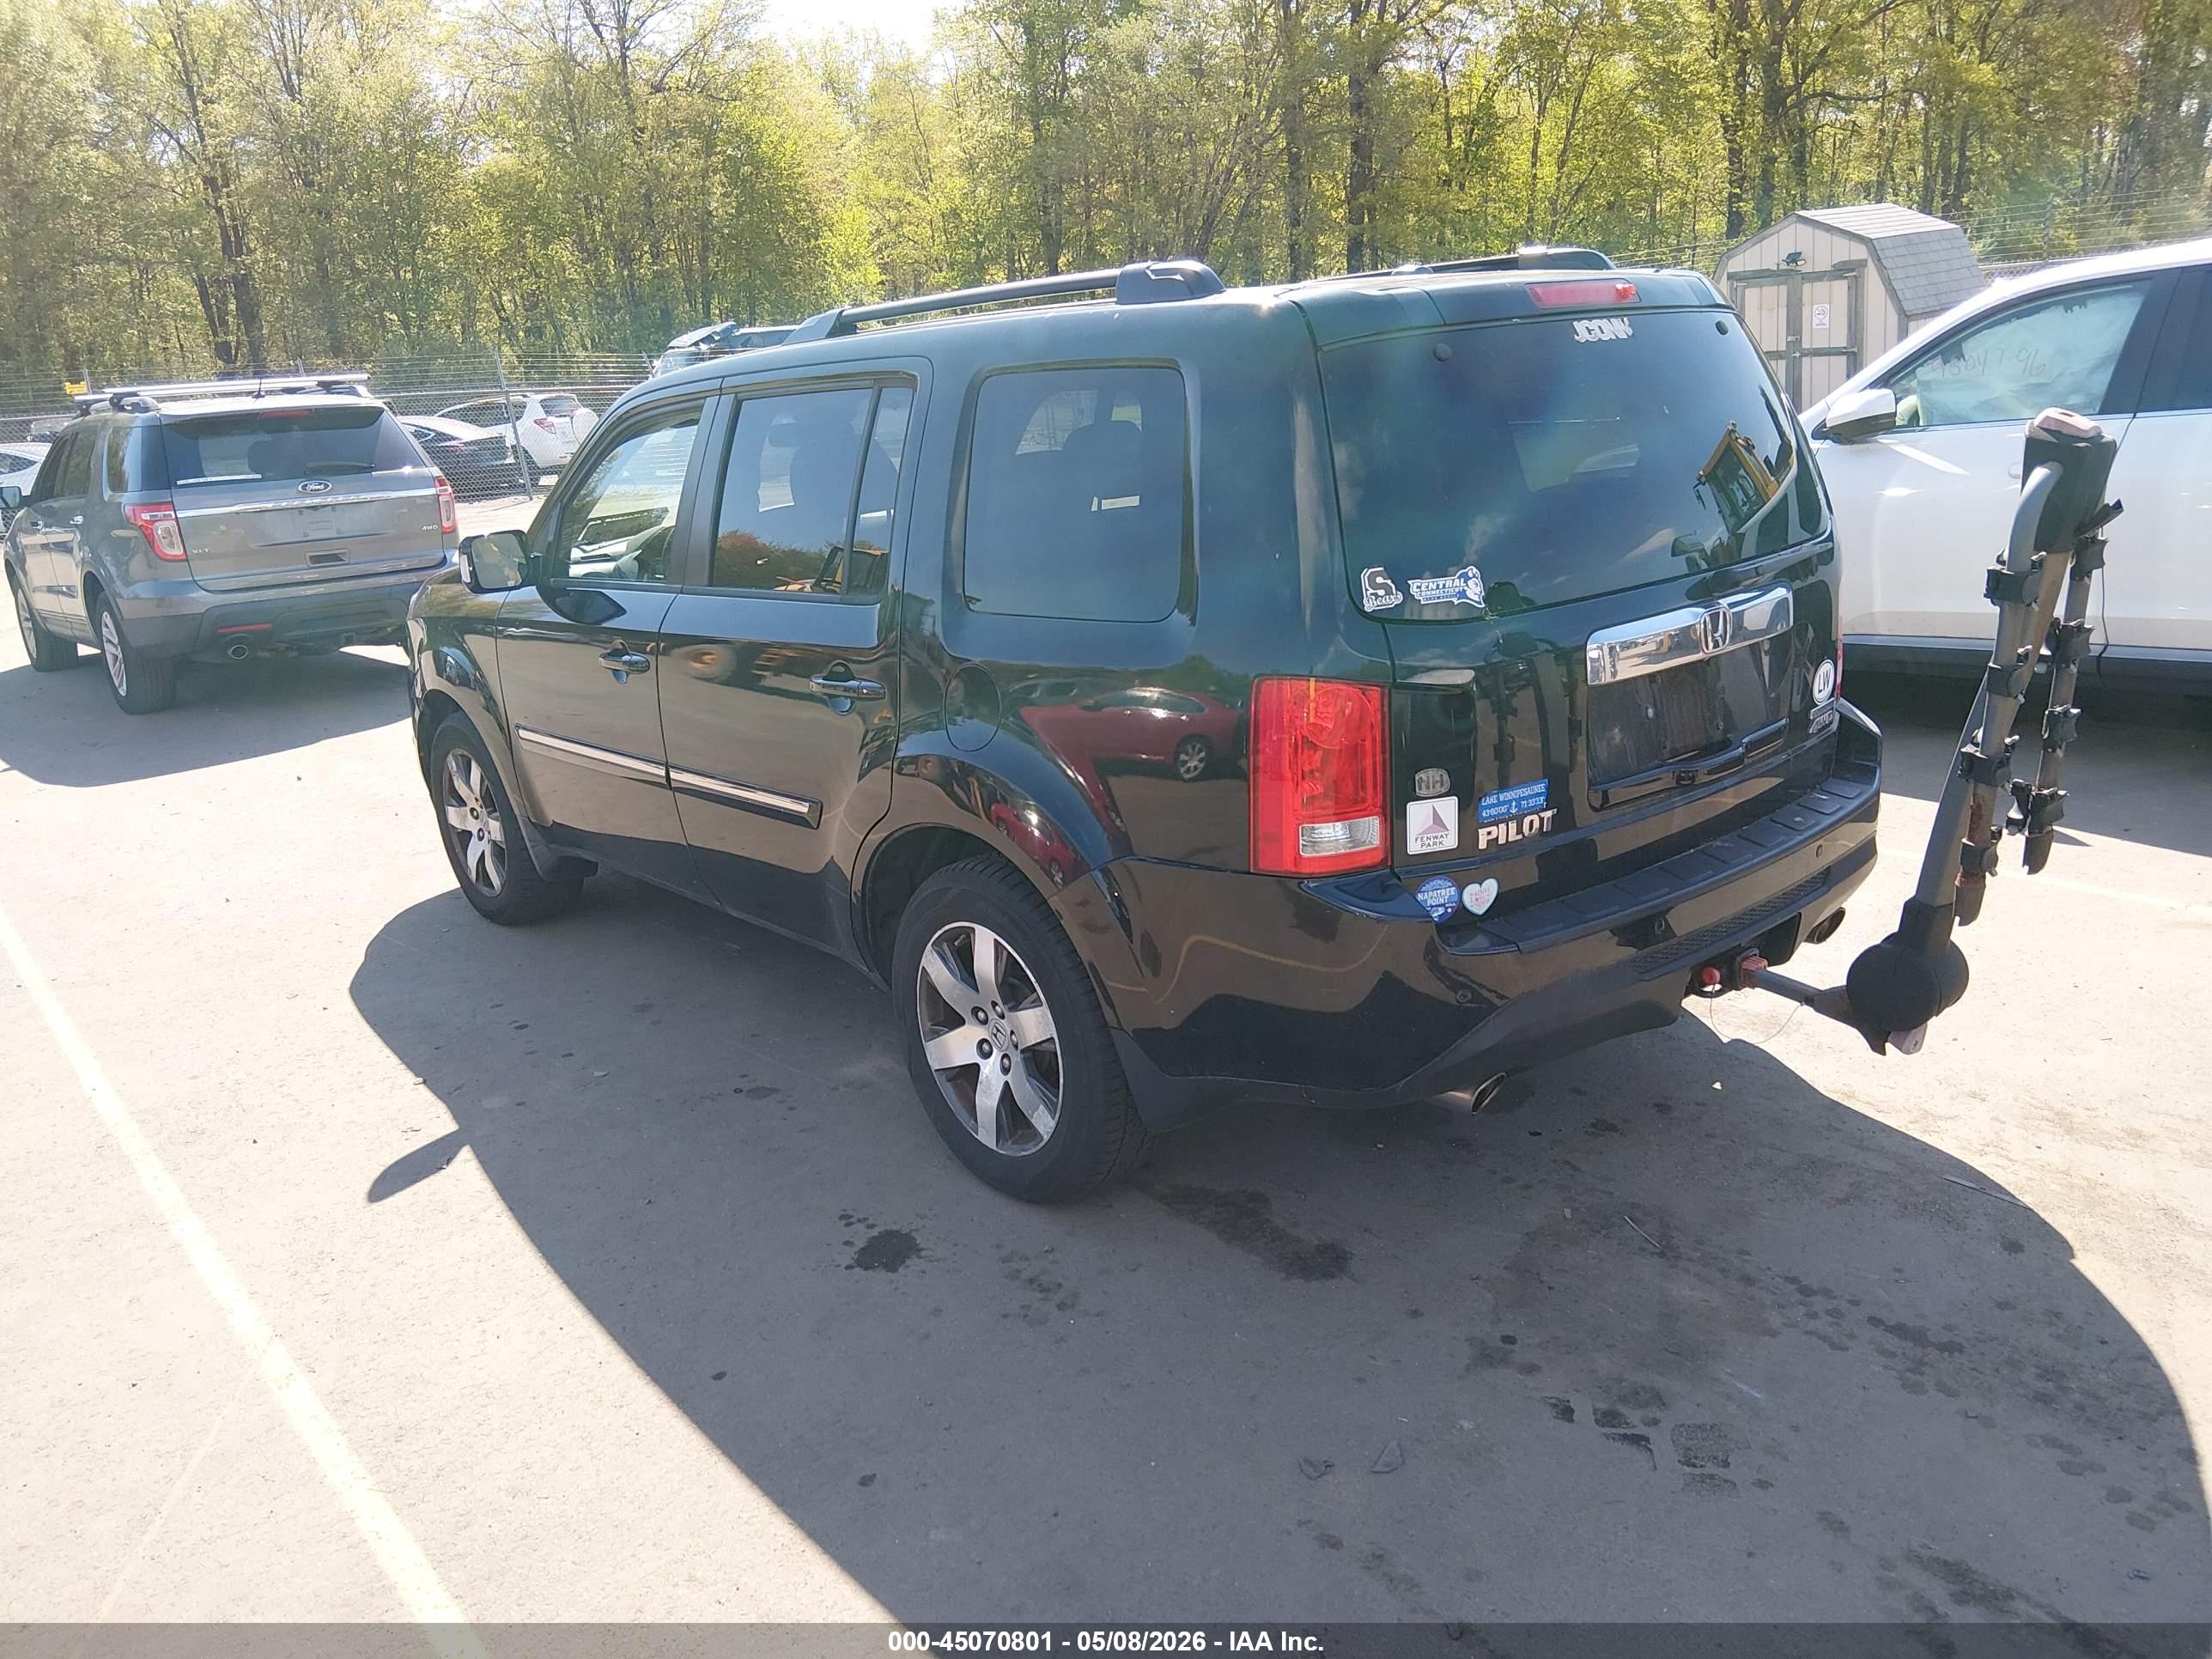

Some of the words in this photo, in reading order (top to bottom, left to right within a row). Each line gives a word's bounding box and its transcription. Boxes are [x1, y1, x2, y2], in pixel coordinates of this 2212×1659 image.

[1413, 578, 1467, 592] CENTRAL
[1417, 586, 1465, 597] CONNECTICUT
[1817, 667, 1831, 695] LW
[1418, 774, 1443, 791] NH
[1481, 794, 1498, 806] LAKE
[1499, 783, 1546, 801] WINNIPESAUKEE
[1478, 808, 1558, 850] PILOT
[1415, 832, 1450, 844] FENWAY
[1420, 841, 1444, 849] PARK
[1417, 886, 1455, 901] NAPATREE
[1427, 896, 1449, 907] POINT
